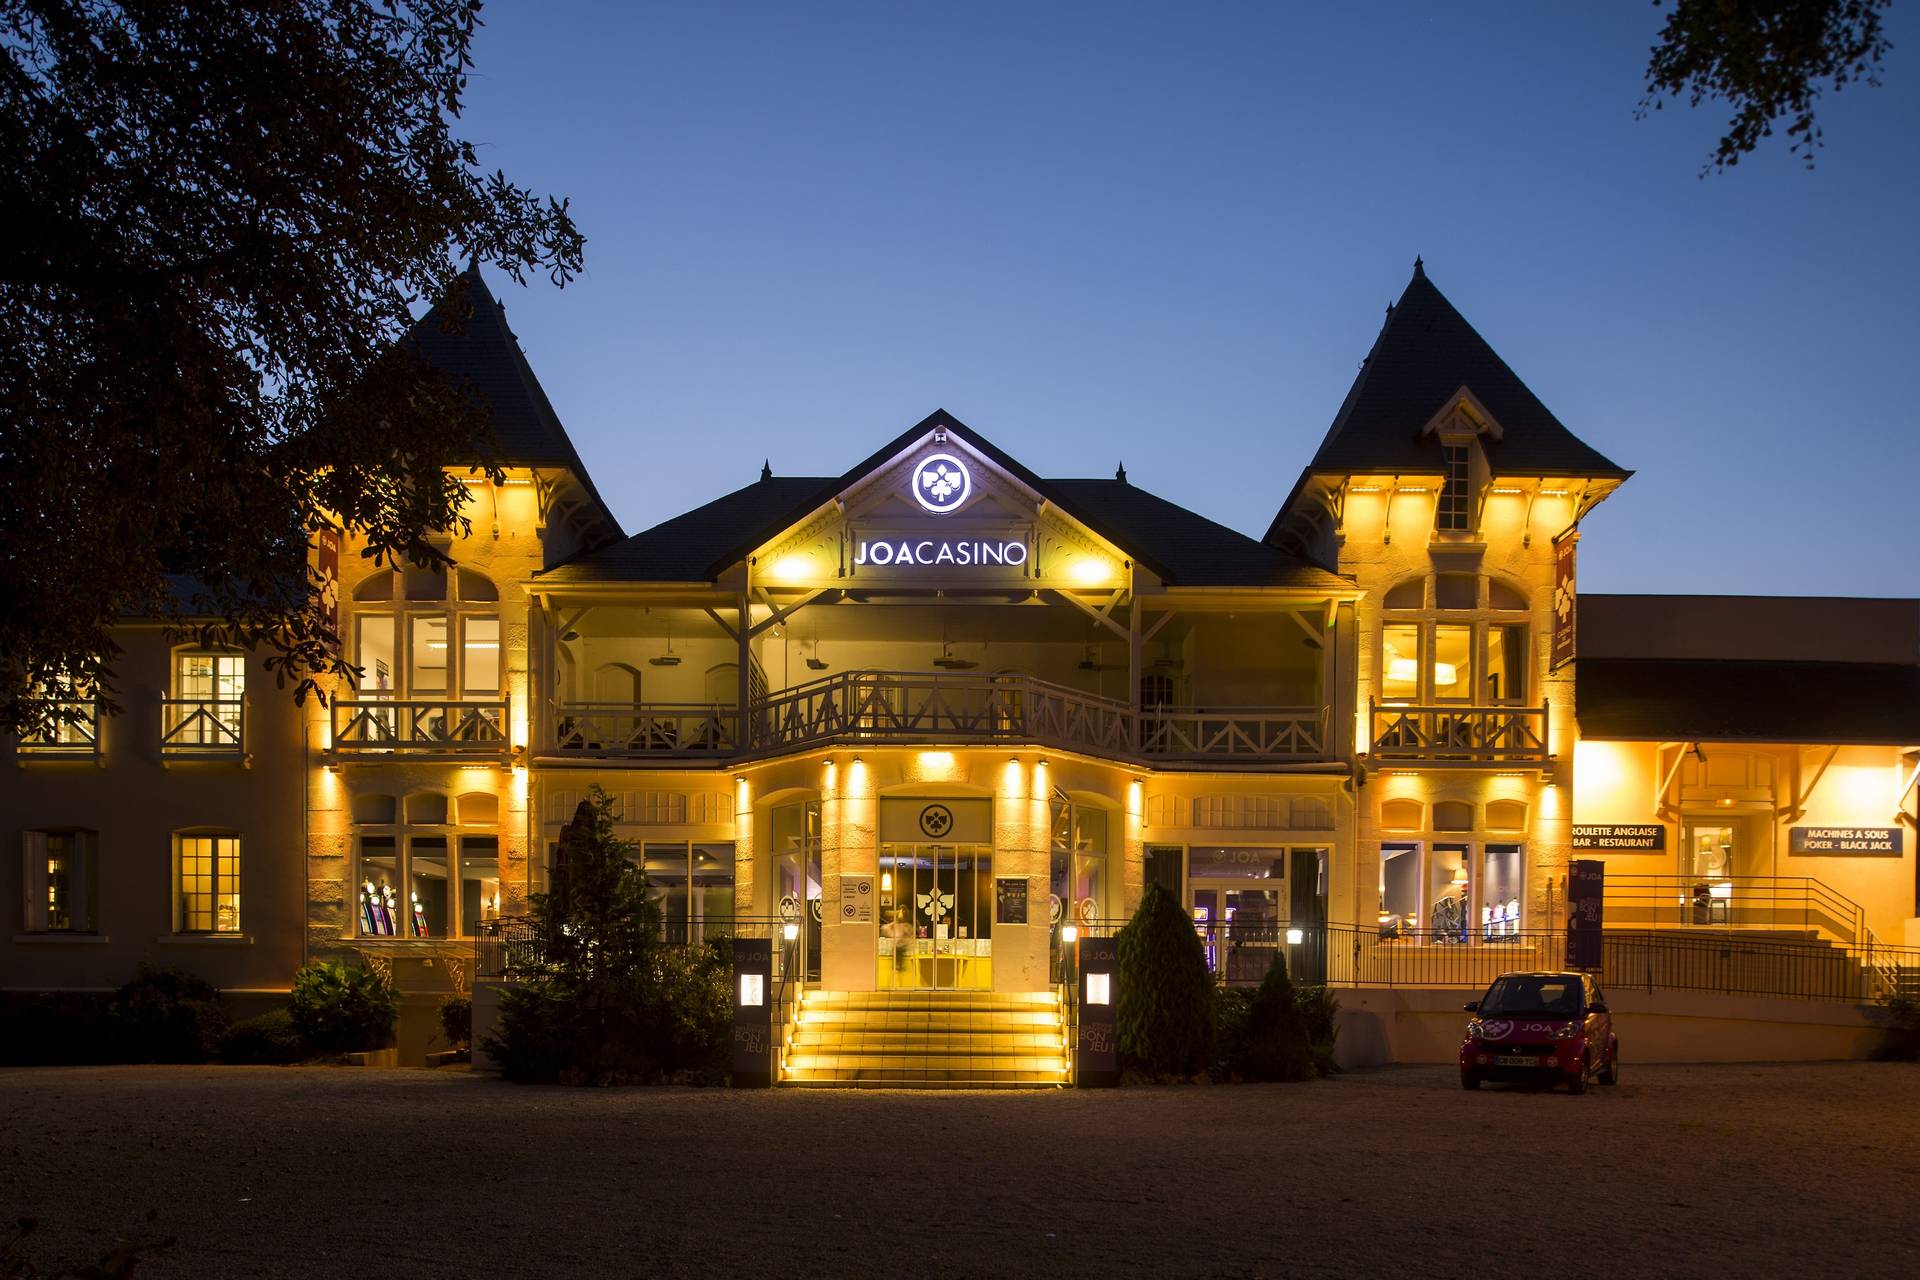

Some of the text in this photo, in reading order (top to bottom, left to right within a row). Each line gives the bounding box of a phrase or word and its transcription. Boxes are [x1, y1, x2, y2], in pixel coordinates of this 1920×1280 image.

[854, 541, 1027, 566] JOACASINO
[1614, 827, 1657, 836] ANGLAISE
[1808, 830, 1889, 839] MACHINES A SOUS
[1573, 838, 1591, 847] BAR
[1599, 838, 1654, 847] RESTAURANT
[1804, 841, 1833, 849] POKER
[1840, 841, 1868, 850] BLACK
[1869, 841, 1893, 850] JACK
[1230, 851, 1260, 864] JOA
[746, 952, 769, 961] JOA
[1093, 951, 1116, 961] JOA
[1521, 1023, 1553, 1032] JOA
[735, 1031, 760, 1042] BON
[1080, 1031, 1106, 1042] BON
